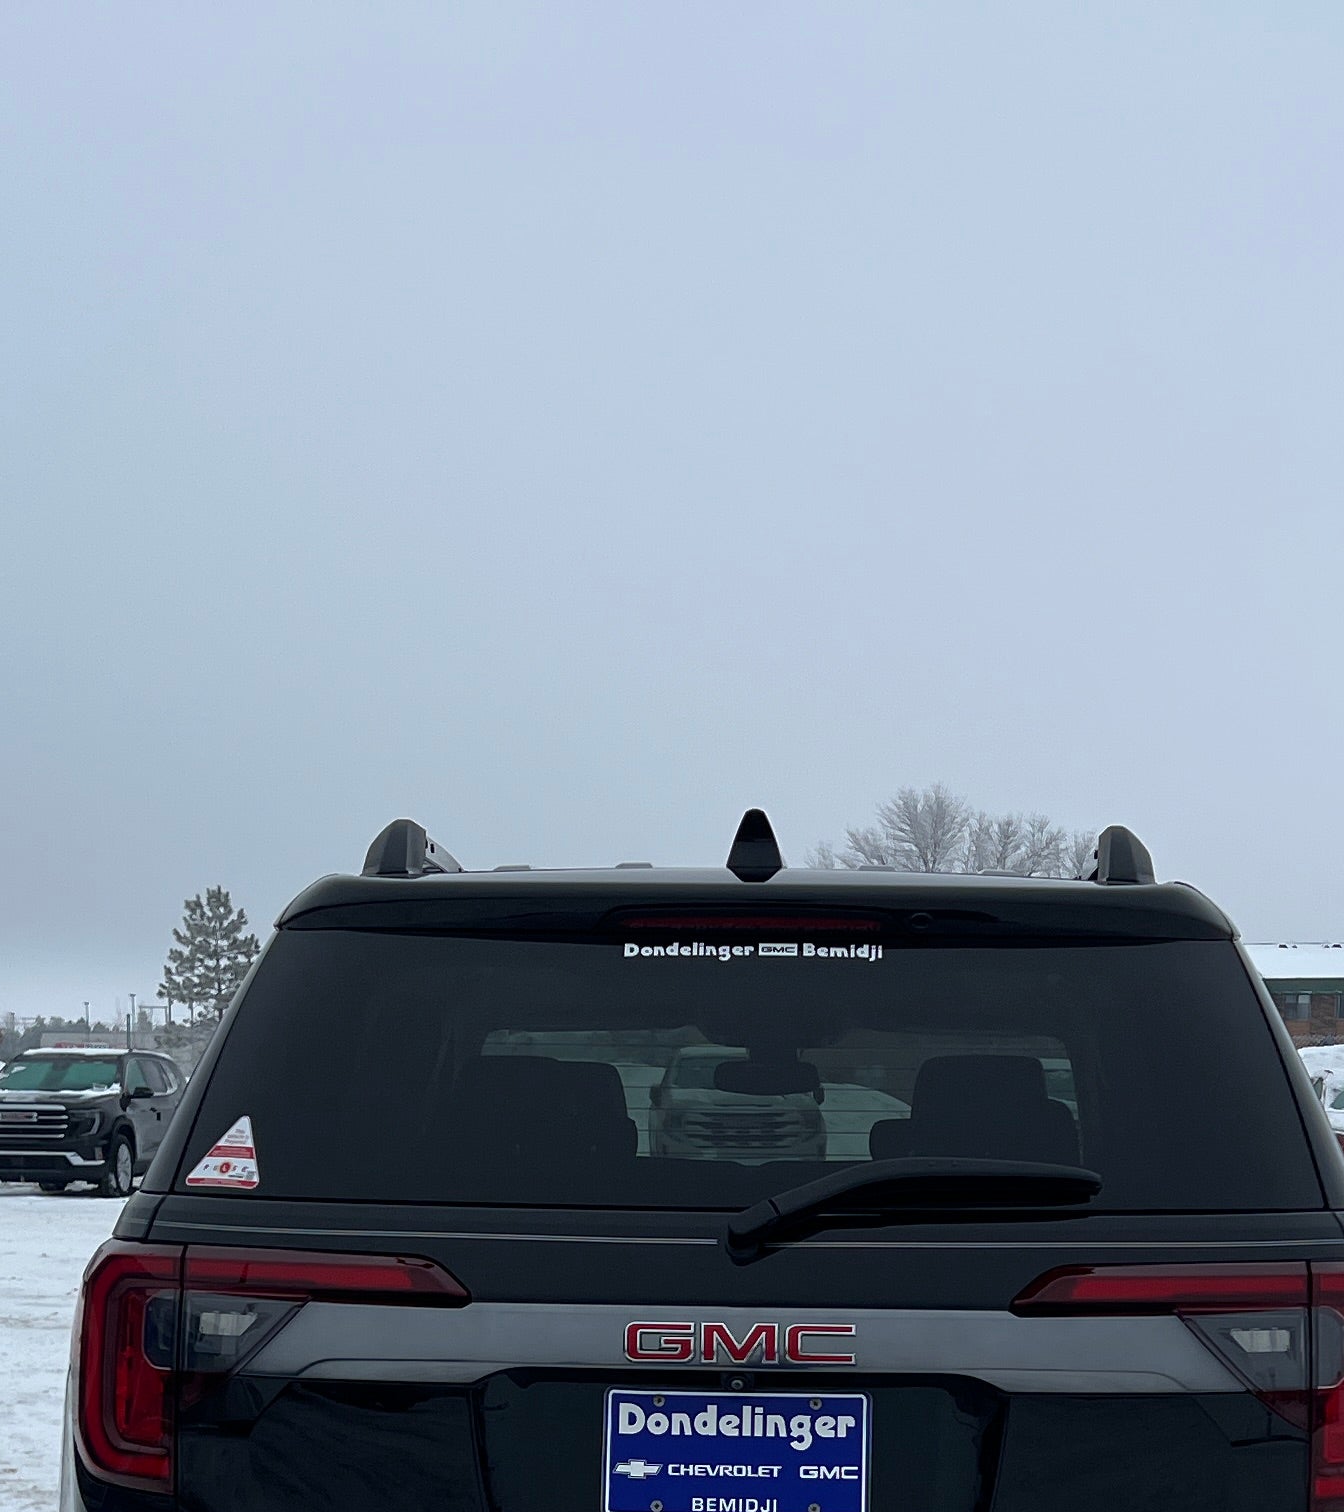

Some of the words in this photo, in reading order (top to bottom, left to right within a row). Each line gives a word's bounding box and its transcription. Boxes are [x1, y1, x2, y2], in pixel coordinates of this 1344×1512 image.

[623, 942, 755, 961] Dondelinger
[803, 943, 883, 961] Bemidji
[625, 1321, 856, 1364] GMC
[618, 1402, 855, 1451] Dondelinger
[667, 1463, 782, 1478] CHEVROLET
[799, 1465, 859, 1480] GMC
[691, 1497, 777, 1512] BEMIDJI
